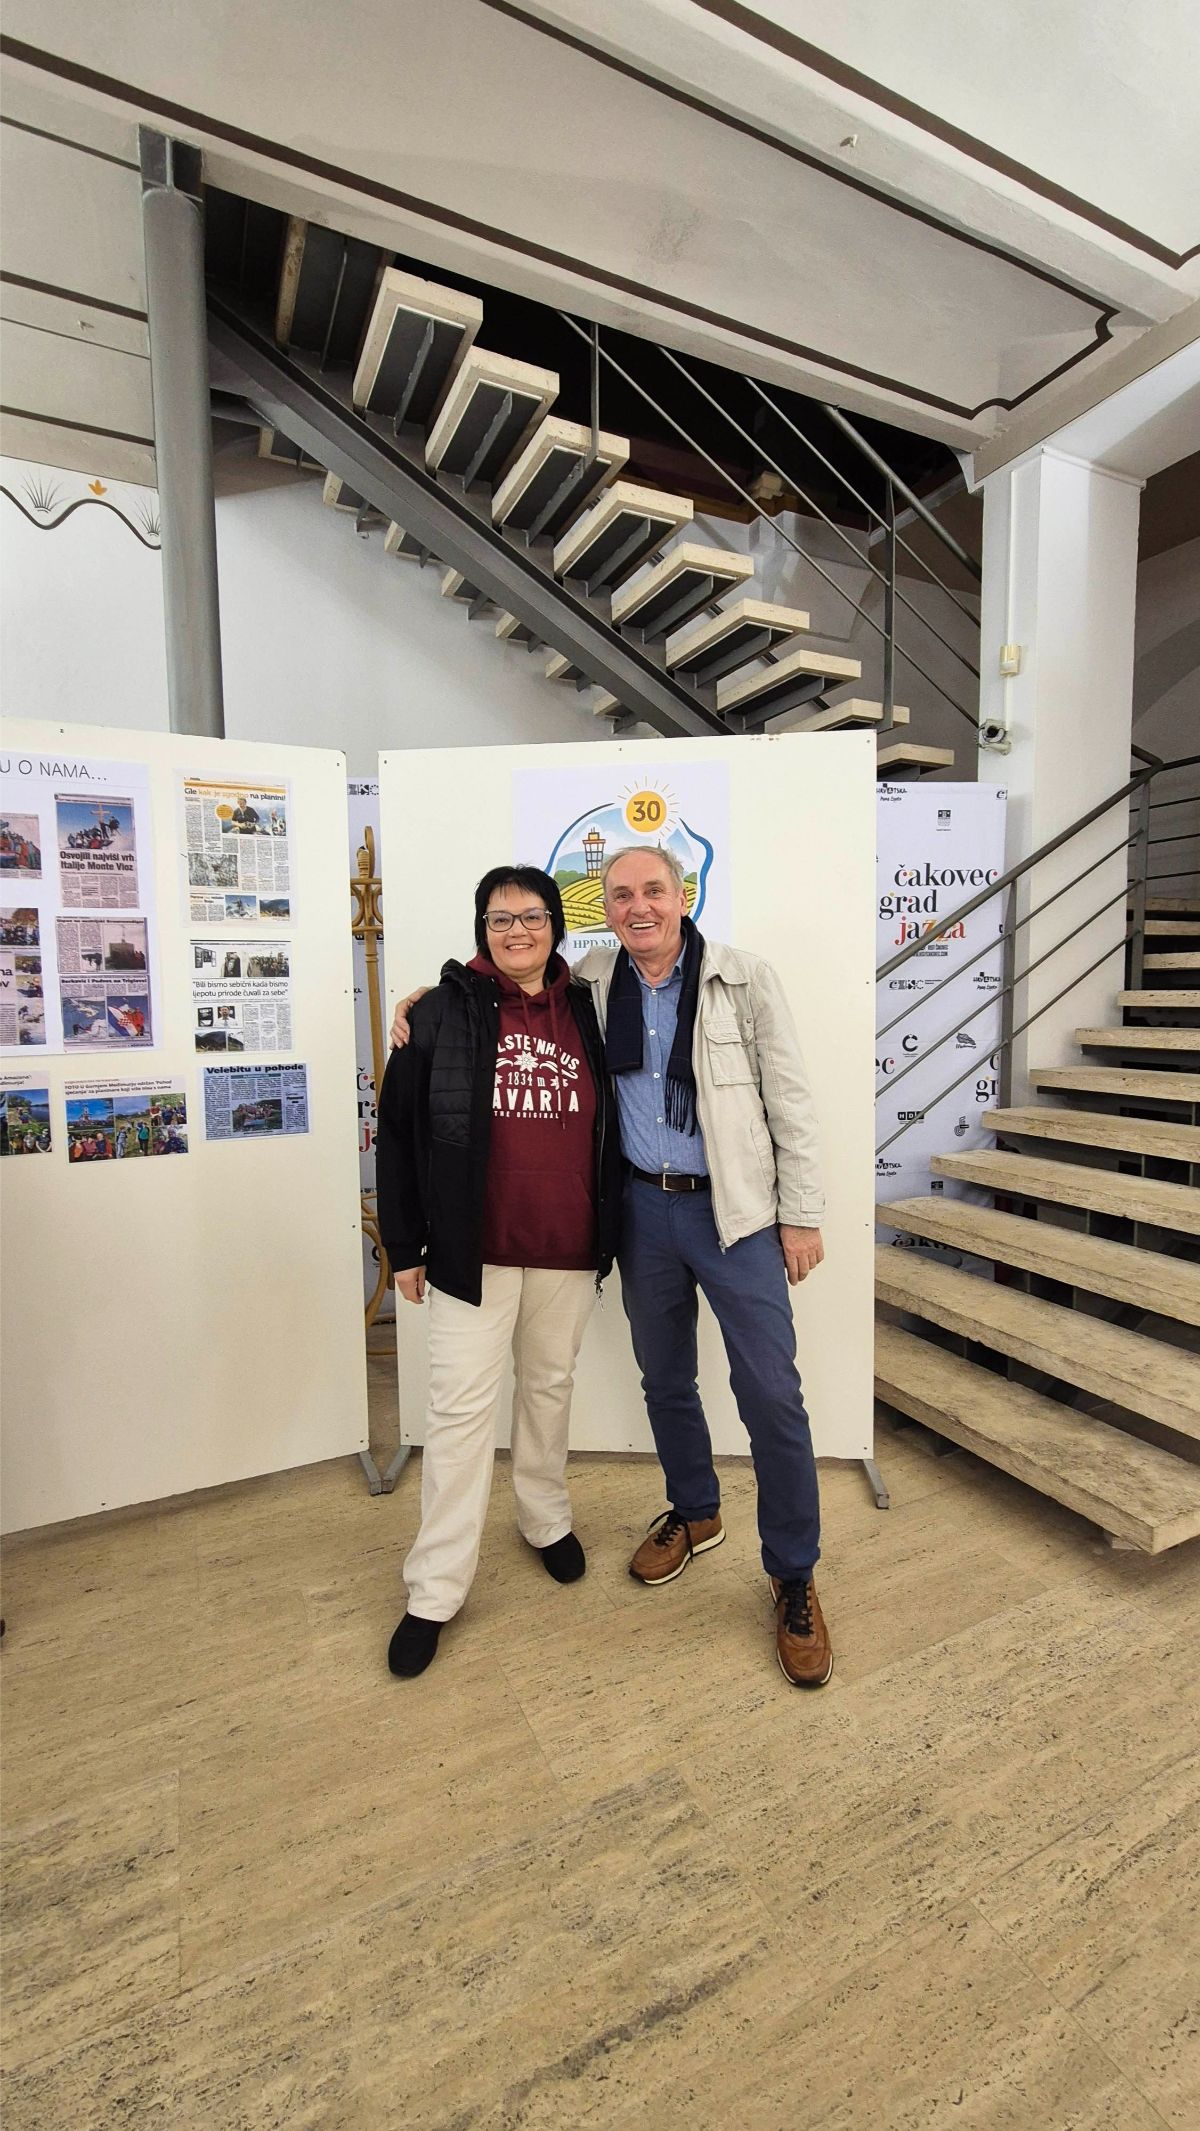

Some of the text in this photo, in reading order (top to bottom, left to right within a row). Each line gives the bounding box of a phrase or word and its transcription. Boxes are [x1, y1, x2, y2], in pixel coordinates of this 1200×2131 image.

[18, 759, 32, 775] O
[184, 787, 197, 795] Gle
[632, 800, 661, 822] 30
[60, 851, 91, 862] Osvojili
[121, 853, 135, 862] vrh
[60, 861, 85, 871] Italije
[87, 862, 114, 871] Monte
[894, 862, 998, 887] čakovec
[878, 889, 939, 921] grad
[206, 1065, 252, 1074] Velebitu
[264, 1063, 304, 1073] pohode
[507, 1071, 546, 1087] 1834 m
[493, 1110, 560, 1119] THE ORIGINAL
